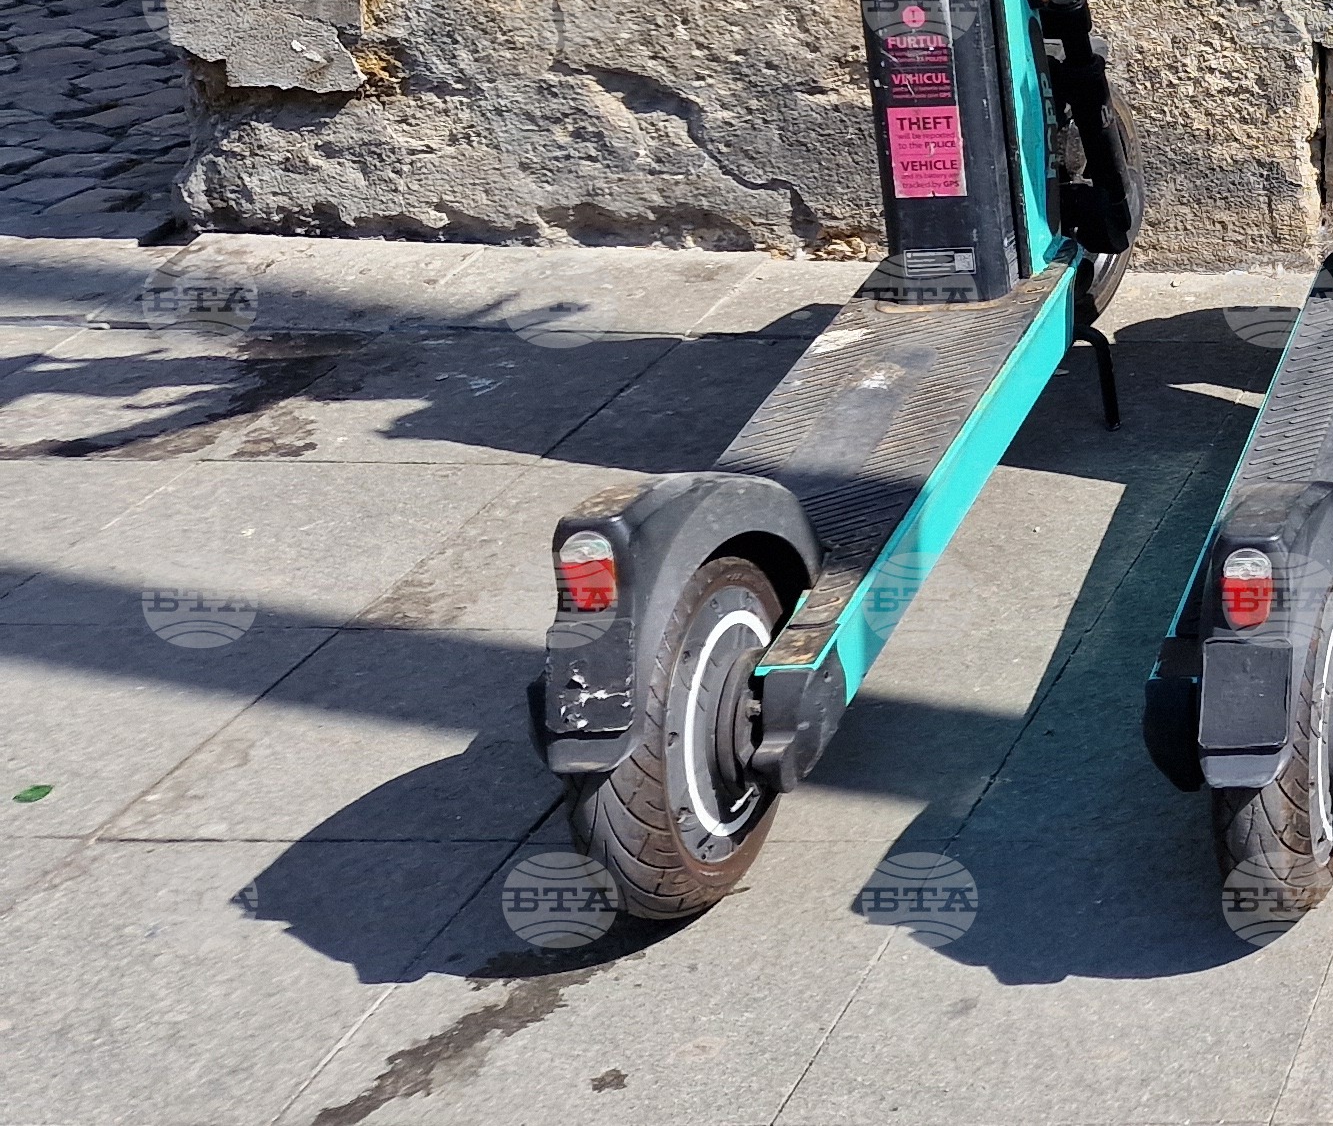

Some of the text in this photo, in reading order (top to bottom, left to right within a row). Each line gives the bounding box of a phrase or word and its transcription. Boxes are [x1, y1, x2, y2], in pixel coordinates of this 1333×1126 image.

[887, 35, 946, 49] FURTUL
[891, 72, 951, 85] VEHICUL
[896, 115, 953, 131] THEFT
[909, 141, 923, 149] the
[924, 140, 957, 149] POLICE
[900, 159, 959, 172] VEHICLE
[943, 180, 960, 188] GPS
